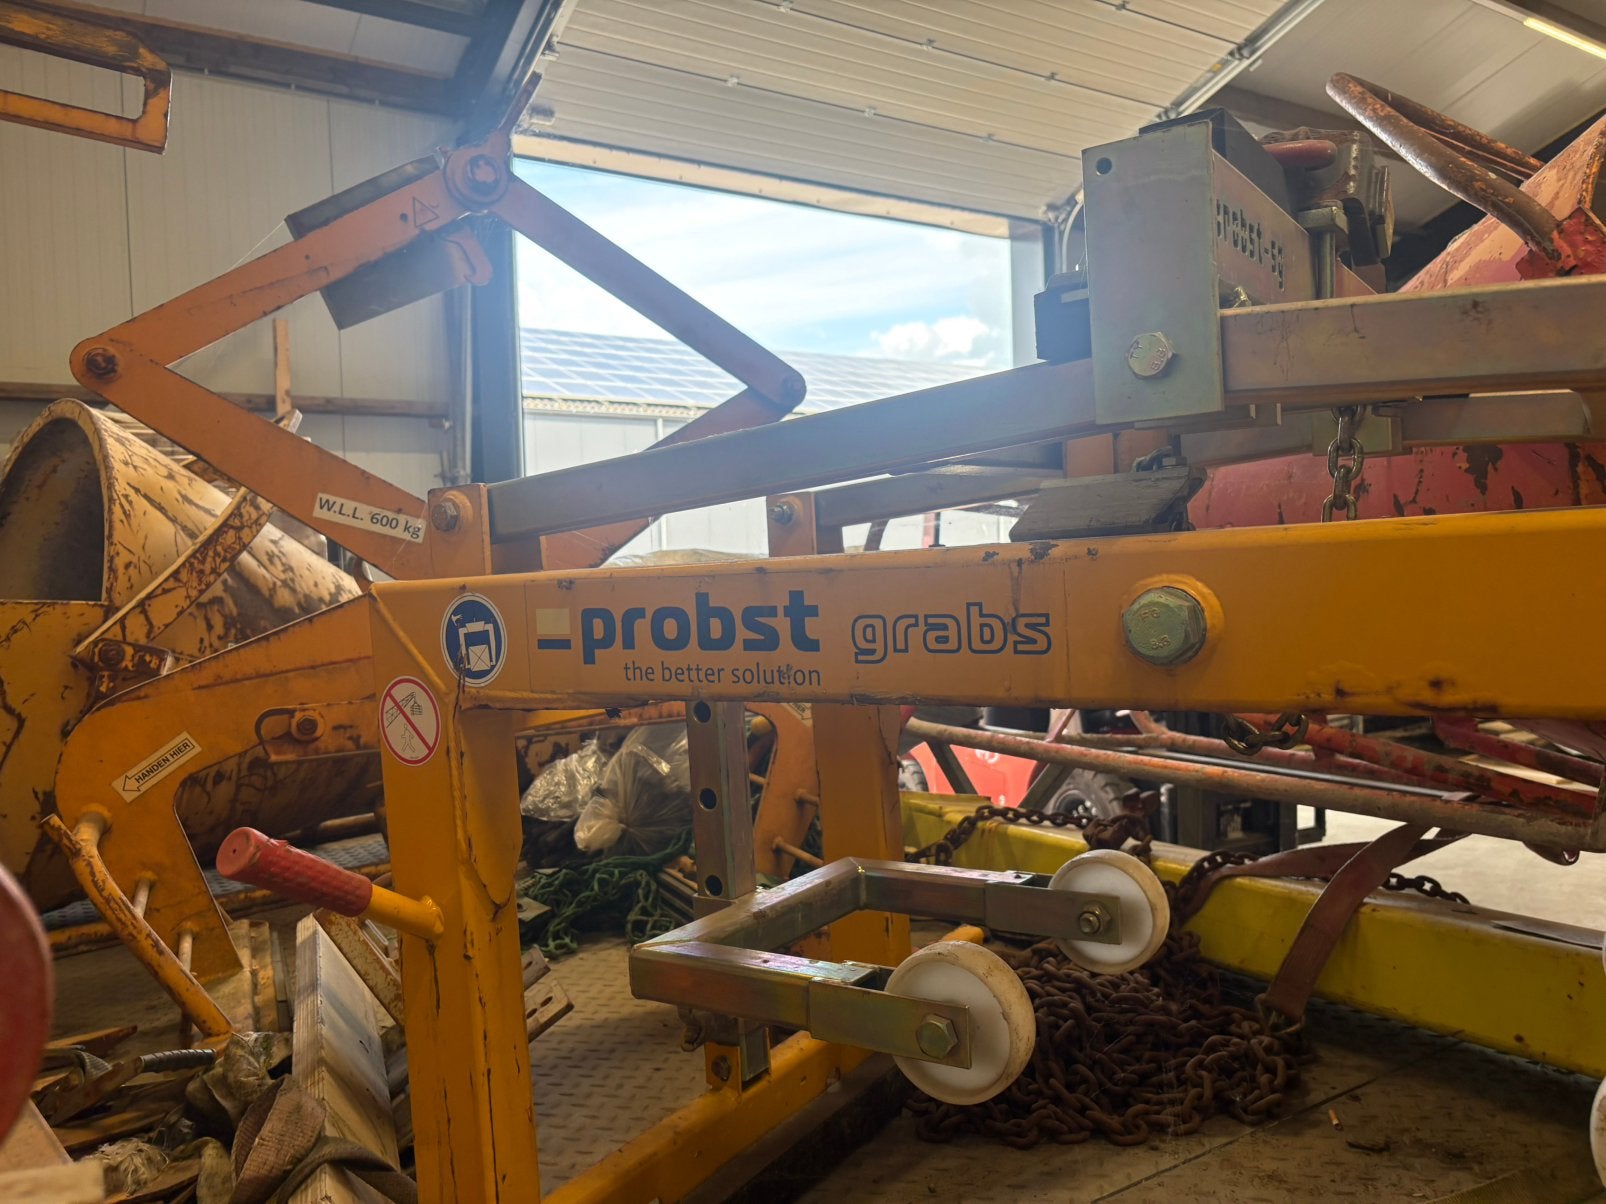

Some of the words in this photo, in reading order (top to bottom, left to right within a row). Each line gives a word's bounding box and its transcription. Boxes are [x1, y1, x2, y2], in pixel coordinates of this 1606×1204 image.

[319, 496, 364, 521] W.L.L.
[370, 512, 399, 530] 600
[403, 519, 422, 539] kg
[580, 590, 821, 665] probst
[851, 601, 1052, 664] grabs
[623, 661, 655, 682] the
[661, 661, 725, 684] better
[134, 756, 171, 783] HANDEN
[169, 741, 191, 759] HIER
